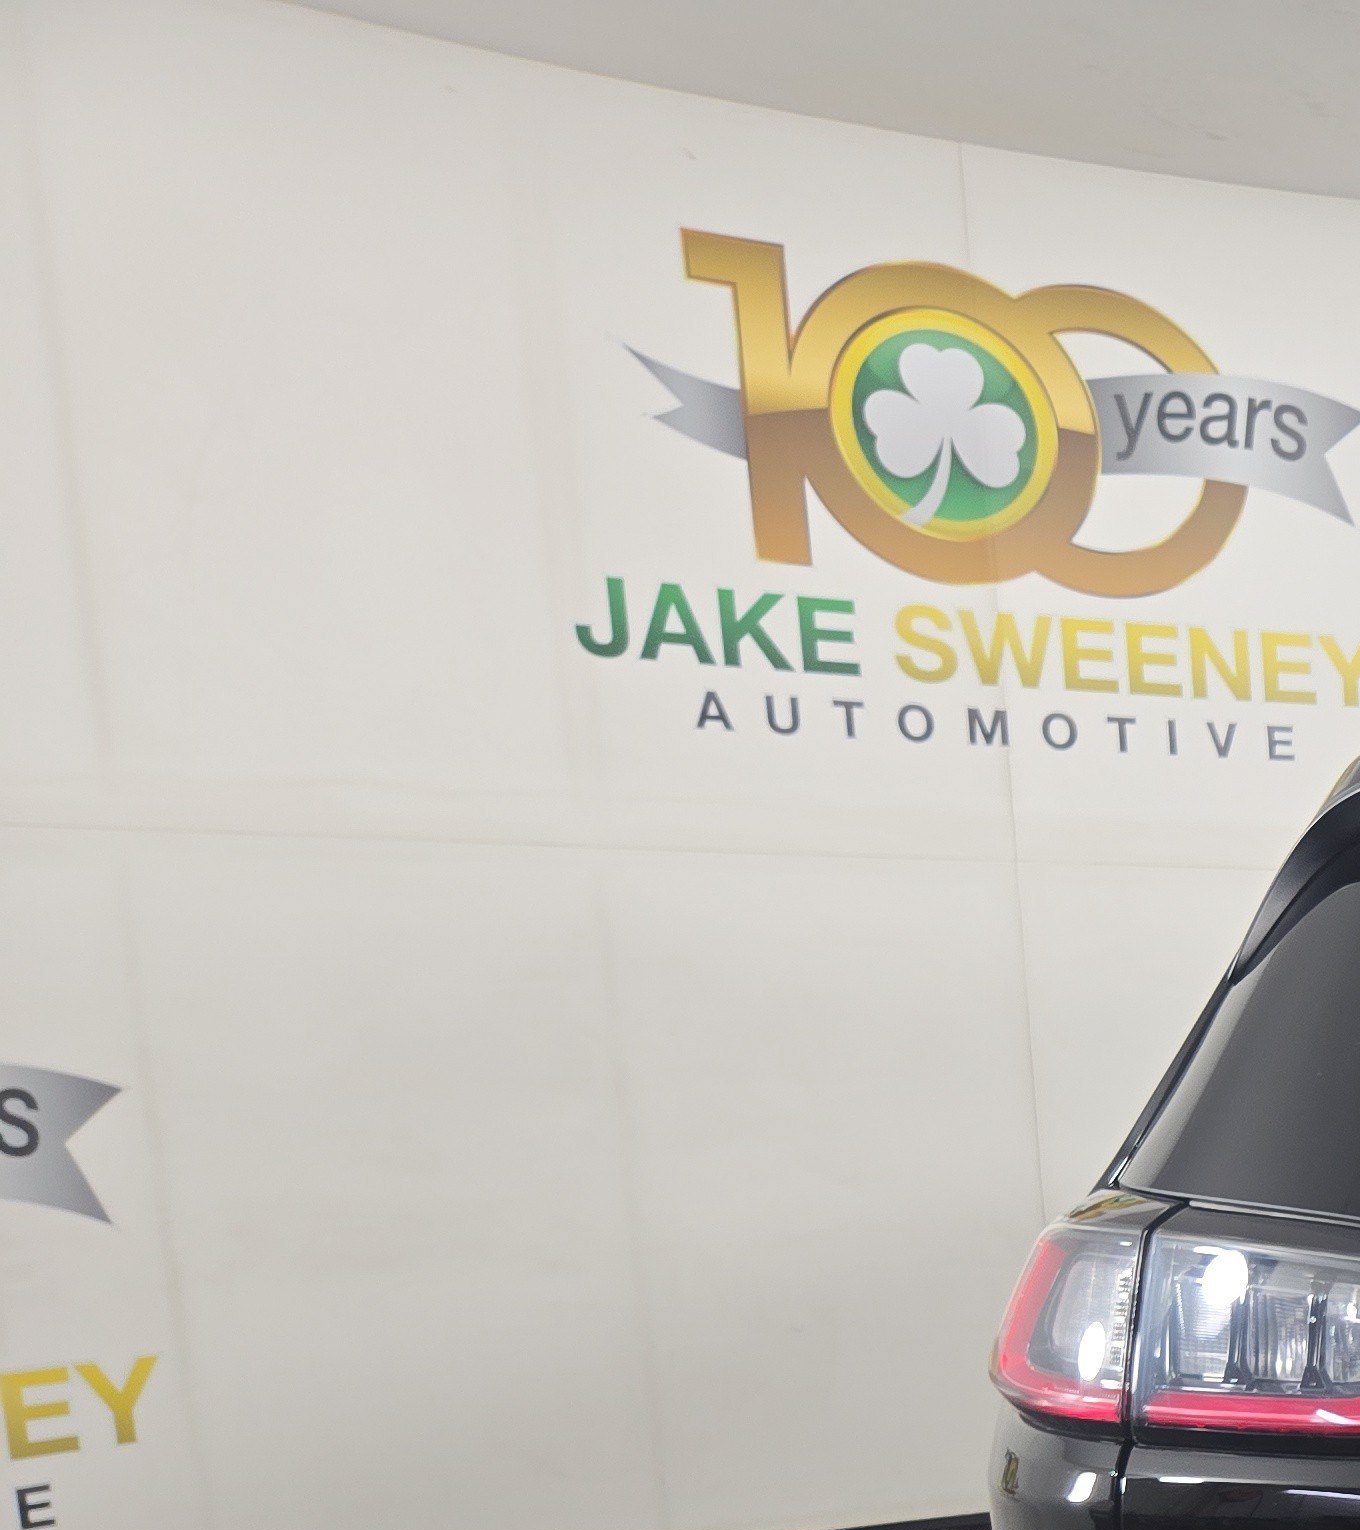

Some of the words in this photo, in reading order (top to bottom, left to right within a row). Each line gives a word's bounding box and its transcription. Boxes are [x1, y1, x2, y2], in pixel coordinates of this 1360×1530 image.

[680, 227, 1249, 599] 100
[1113, 388, 1310, 462] years
[575, 576, 861, 677] JAKE
[695, 691, 1296, 762] AUTOMOTIVE
